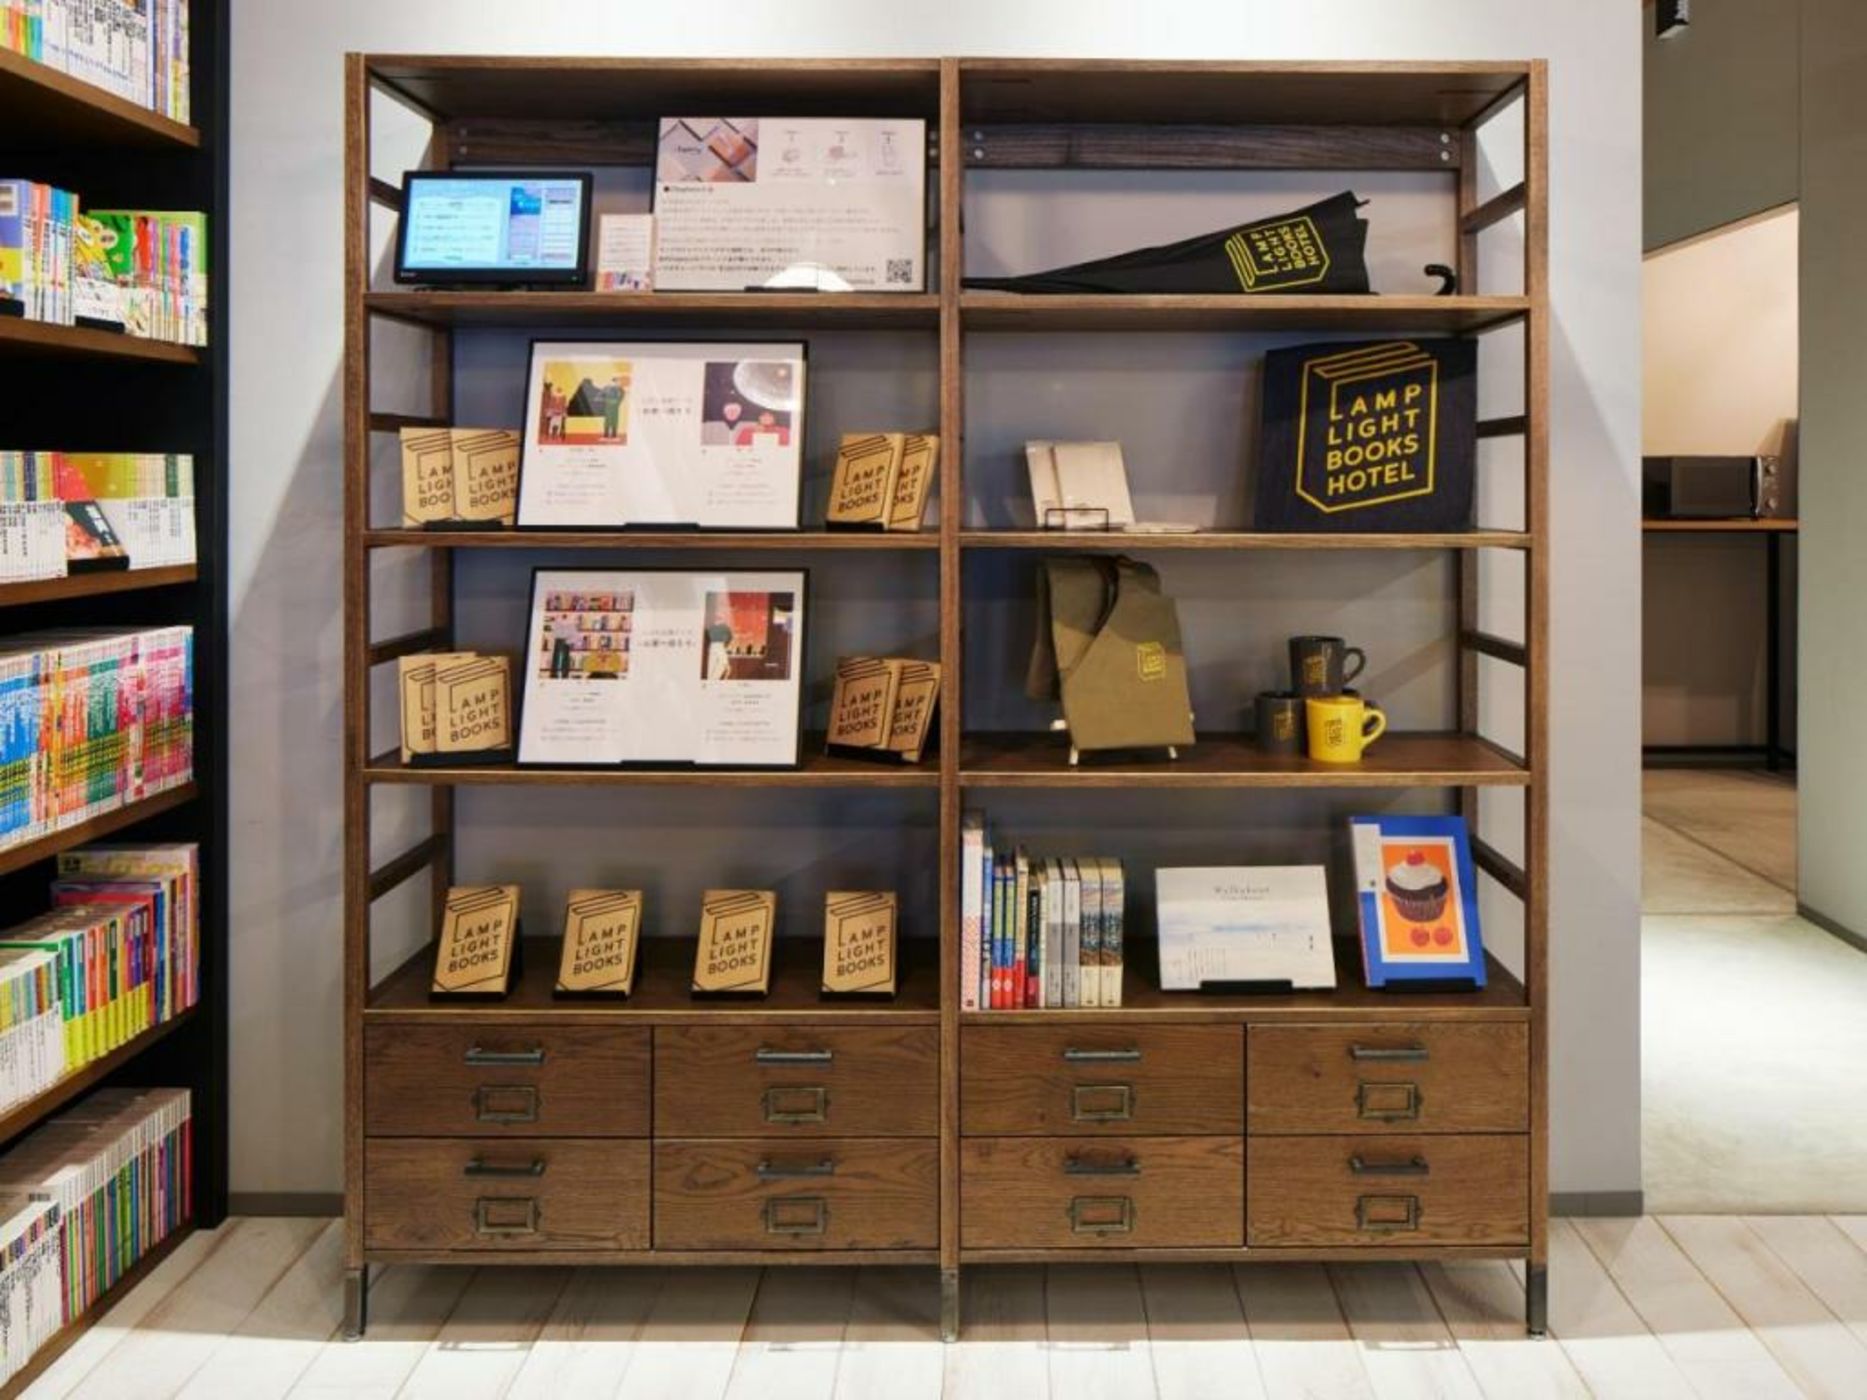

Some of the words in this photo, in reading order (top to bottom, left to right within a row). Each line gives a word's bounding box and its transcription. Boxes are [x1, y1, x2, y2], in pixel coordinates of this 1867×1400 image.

[1250, 232, 1279, 275] LAMP
[1264, 229, 1293, 272] LIGHT
[1278, 225, 1306, 269] BOOKS
[1294, 224, 1320, 266] HOTEL
[1329, 383, 1422, 421] LAMP
[1327, 408, 1420, 445] LIGHT
[1326, 433, 1419, 471] BOOKS
[843, 465, 885, 486] LAMP
[1327, 461, 1415, 496] HOTEL
[419, 492, 451, 508] BOO
[841, 479, 882, 500] LIGHT
[838, 492, 878, 513] BOOKS
[450, 689, 500, 713] LAMP
[841, 688, 882, 708] LAMP
[450, 702, 500, 728] LIGHT
[839, 703, 880, 722] LIGHT
[450, 717, 500, 743] BOOKS
[838, 717, 877, 736] BOOKS
[454, 919, 502, 943] LAMP
[578, 924, 627, 946] LAMP
[712, 924, 760, 946] LAMP
[838, 925, 887, 947] LAMP
[451, 934, 500, 957] LIGHT
[575, 939, 625, 960] LIGHT
[710, 939, 758, 960] LIGHT
[837, 939, 885, 962] LIGHT
[448, 949, 498, 973] BOOKS
[573, 954, 623, 976] BOOKS
[708, 953, 757, 975] BOOKS
[836, 954, 885, 977] BOOKS
